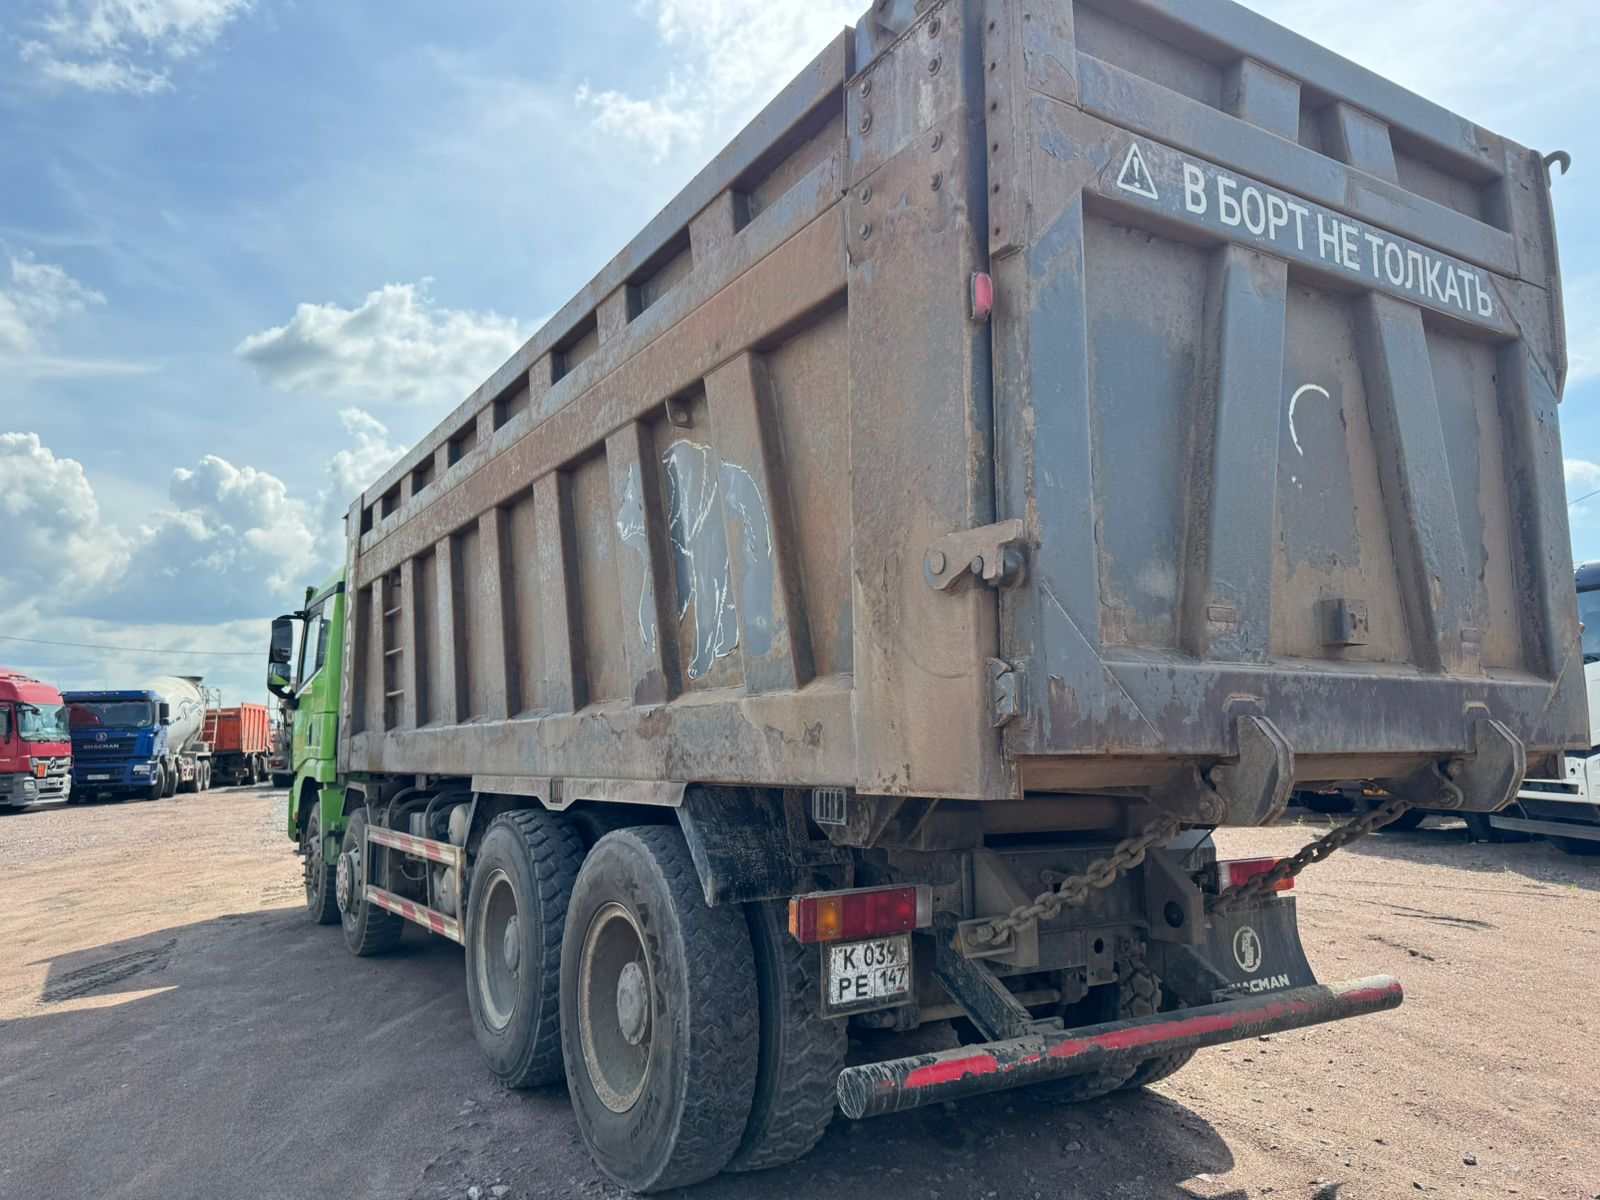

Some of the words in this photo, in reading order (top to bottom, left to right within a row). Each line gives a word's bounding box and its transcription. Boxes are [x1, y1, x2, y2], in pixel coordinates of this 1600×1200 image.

[1182, 161, 1207, 215] В
[1217, 175, 1309, 250] БОРТ
[1317, 213, 1361, 271] НЕ
[1364, 234, 1493, 318] ТОЛКАТЬ
[880, 967, 905, 986] 147
[1228, 973, 1290, 993] CMAN
